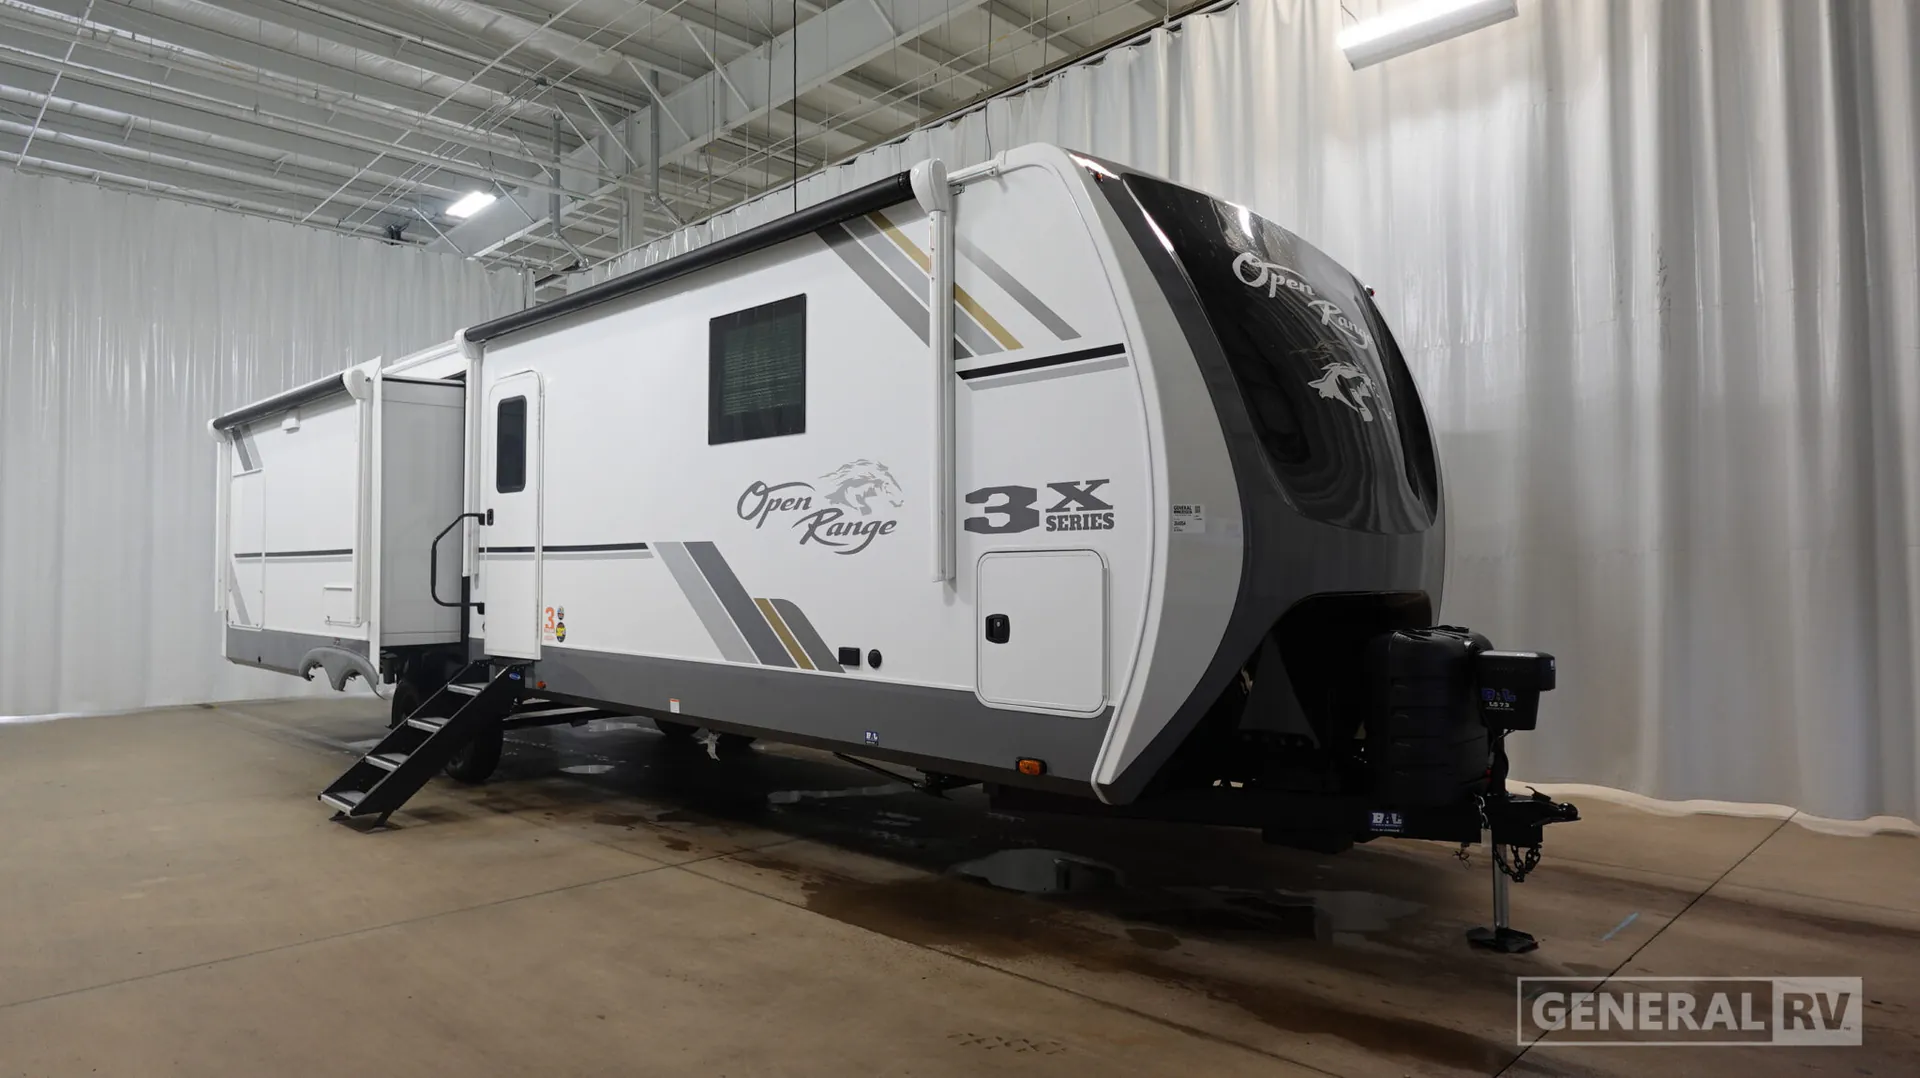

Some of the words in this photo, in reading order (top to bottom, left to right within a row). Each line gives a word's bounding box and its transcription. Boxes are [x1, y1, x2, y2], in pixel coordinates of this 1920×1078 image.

[1232, 252, 1315, 298] Open
[736, 480, 816, 529] Open
[1046, 512, 1114, 532] SERIES
[791, 508, 898, 555] Range
